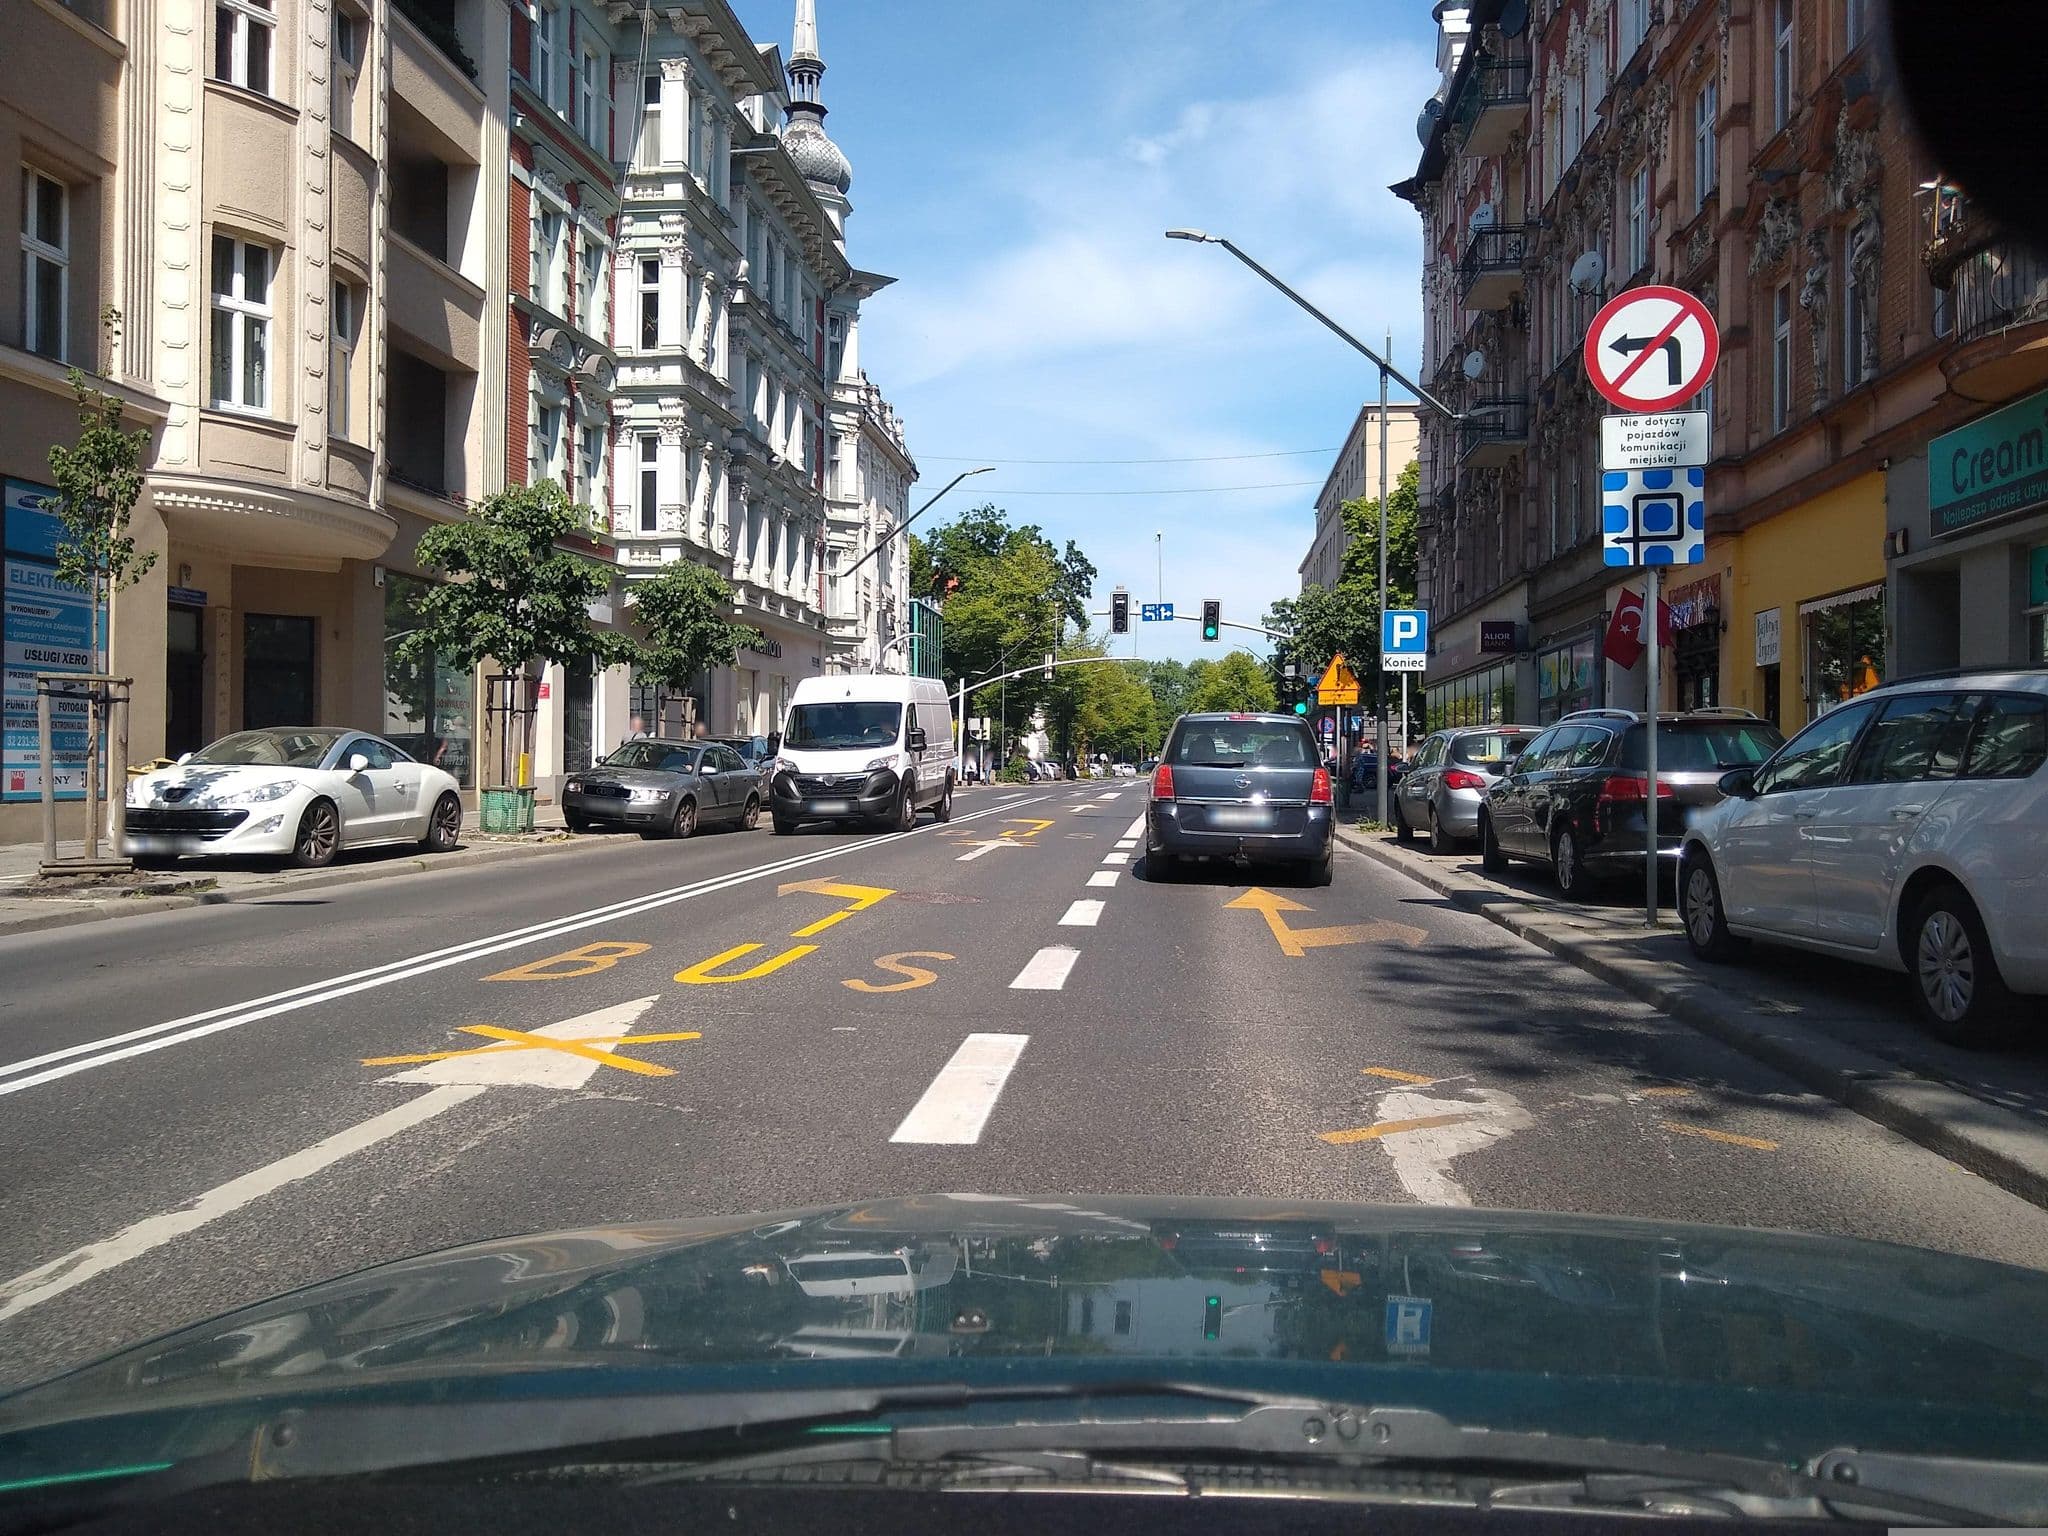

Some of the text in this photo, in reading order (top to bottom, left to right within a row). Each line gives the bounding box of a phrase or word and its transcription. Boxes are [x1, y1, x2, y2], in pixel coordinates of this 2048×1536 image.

[1620, 417, 1686, 428] Nie dotyczy
[1620, 440, 1686, 452] komunikacji
[1629, 454, 1677, 466] miejskiej
[1952, 428, 2043, 494] Cream
[24, 649, 88, 666] USŁUGI XERO
[1384, 657, 1424, 668] Koniec
[479, 941, 956, 992] BUS
